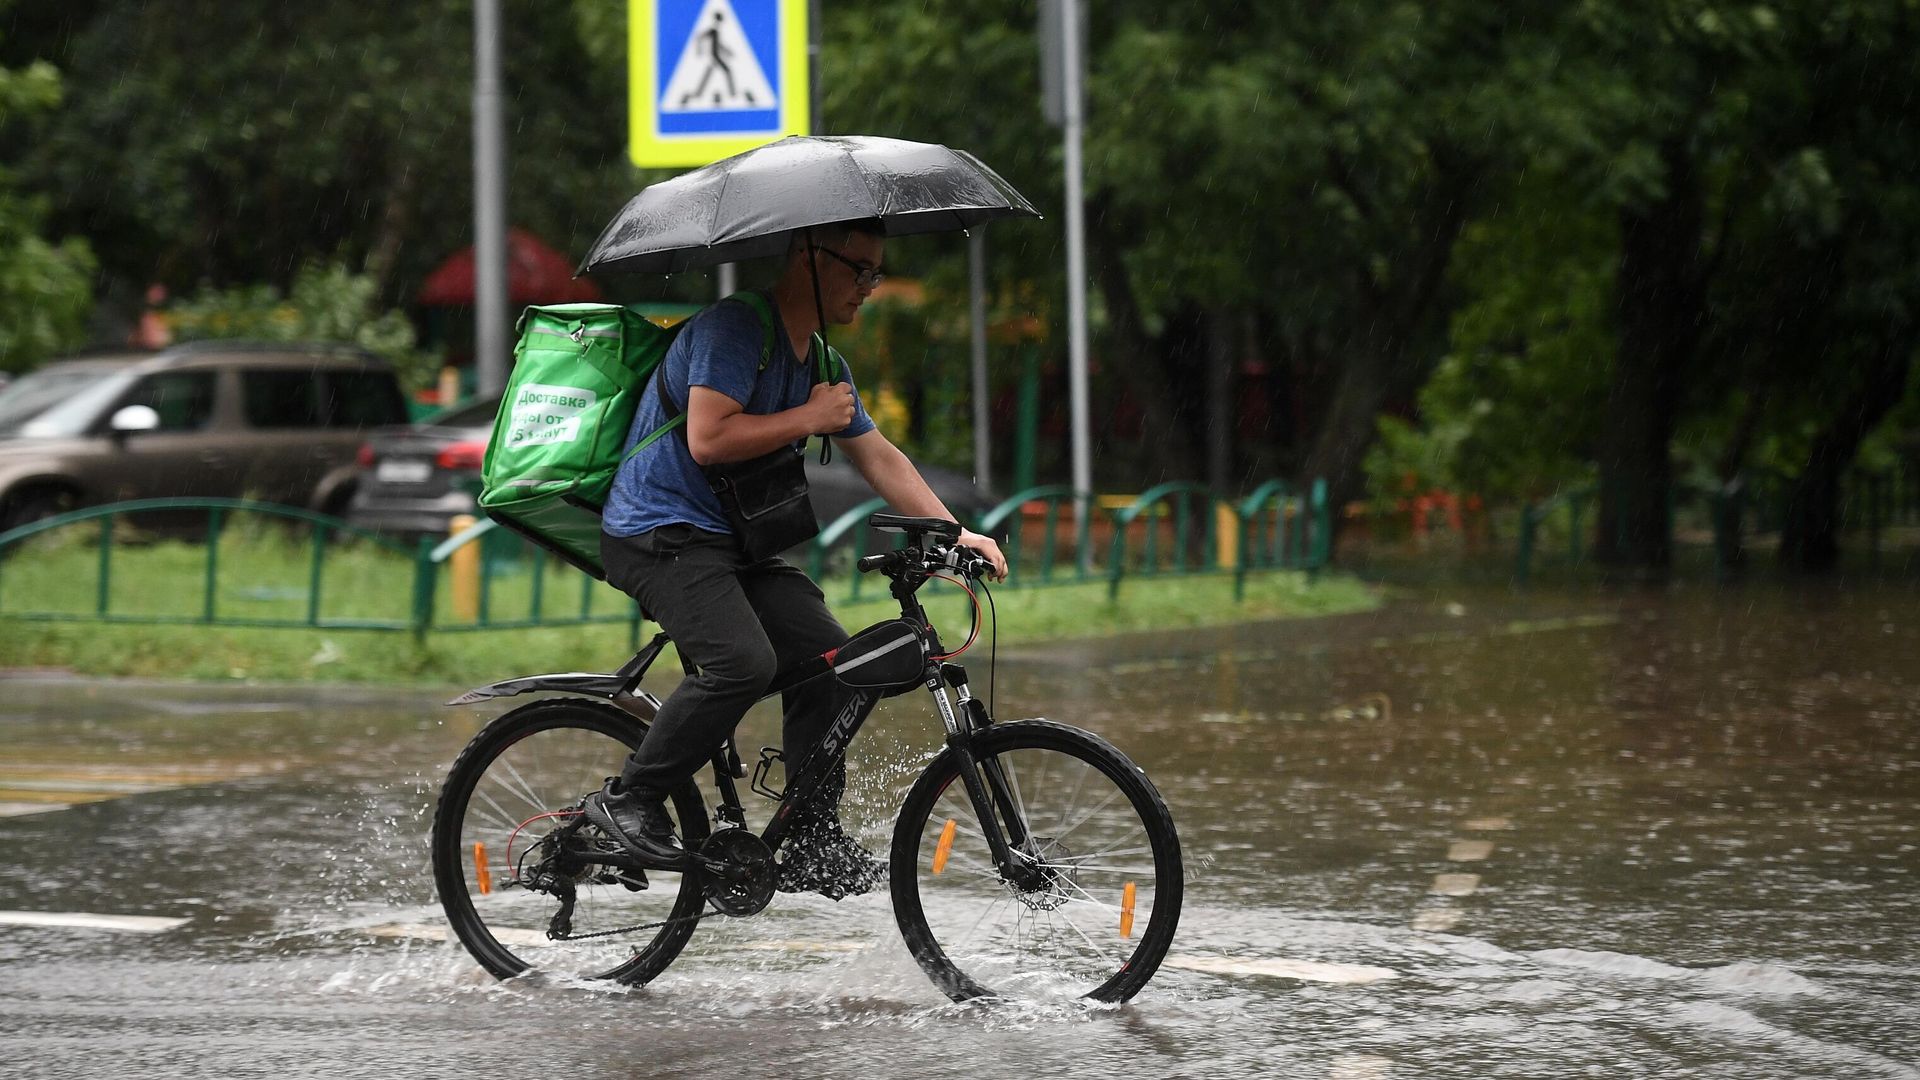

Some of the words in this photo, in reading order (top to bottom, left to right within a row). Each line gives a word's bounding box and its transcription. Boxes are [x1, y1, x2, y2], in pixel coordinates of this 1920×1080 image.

[518, 390, 587, 408] Доставка
[513, 412, 541, 424] ды
[545, 414, 564, 425] от
